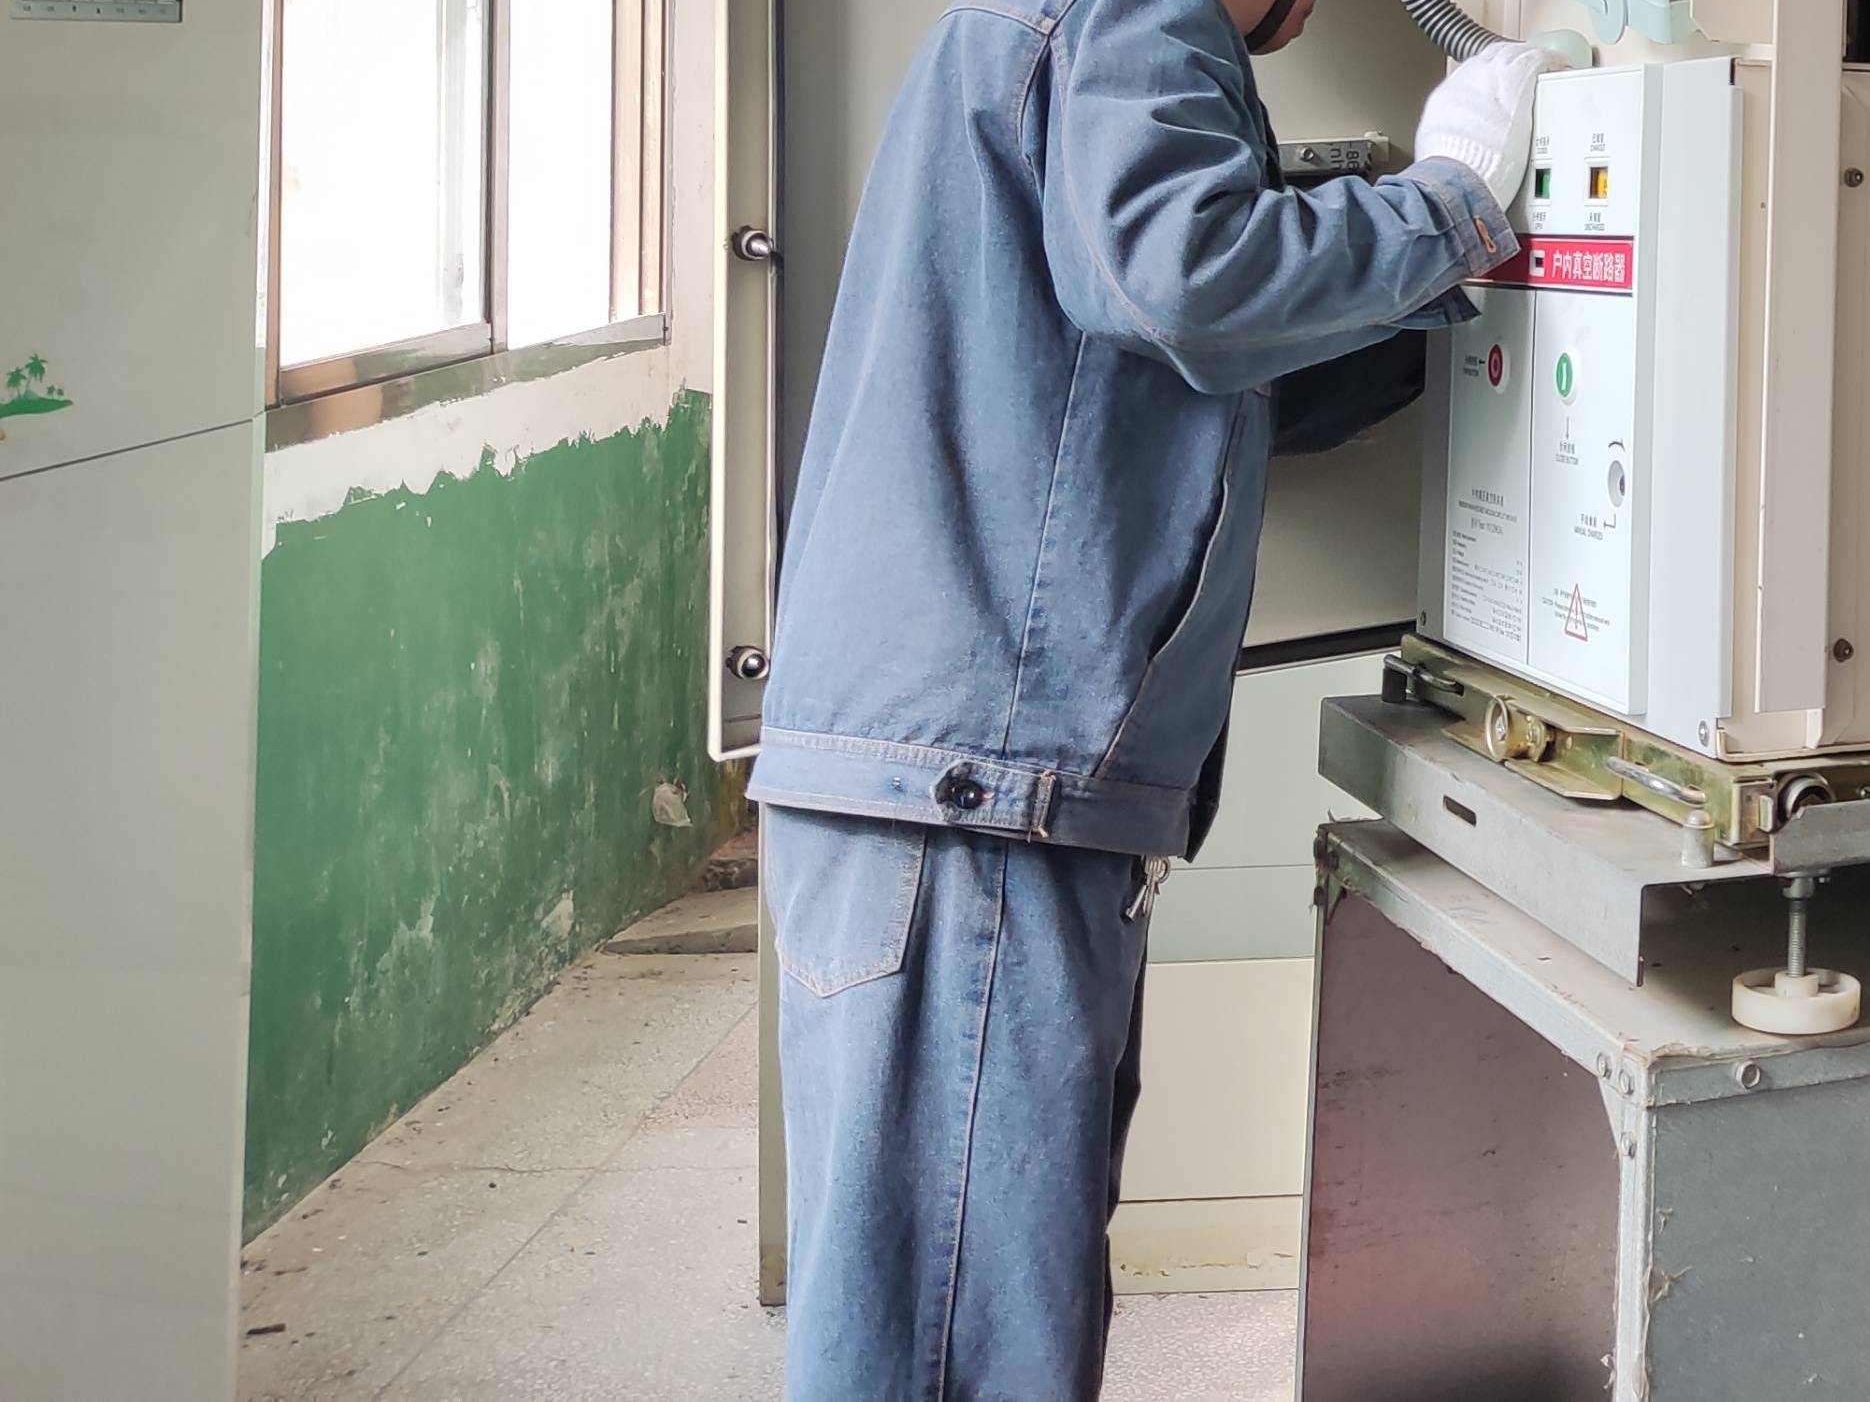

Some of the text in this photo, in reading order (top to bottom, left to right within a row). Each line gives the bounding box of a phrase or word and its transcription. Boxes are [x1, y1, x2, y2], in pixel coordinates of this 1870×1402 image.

[1552, 250, 1626, 283] 户内真空断路器
